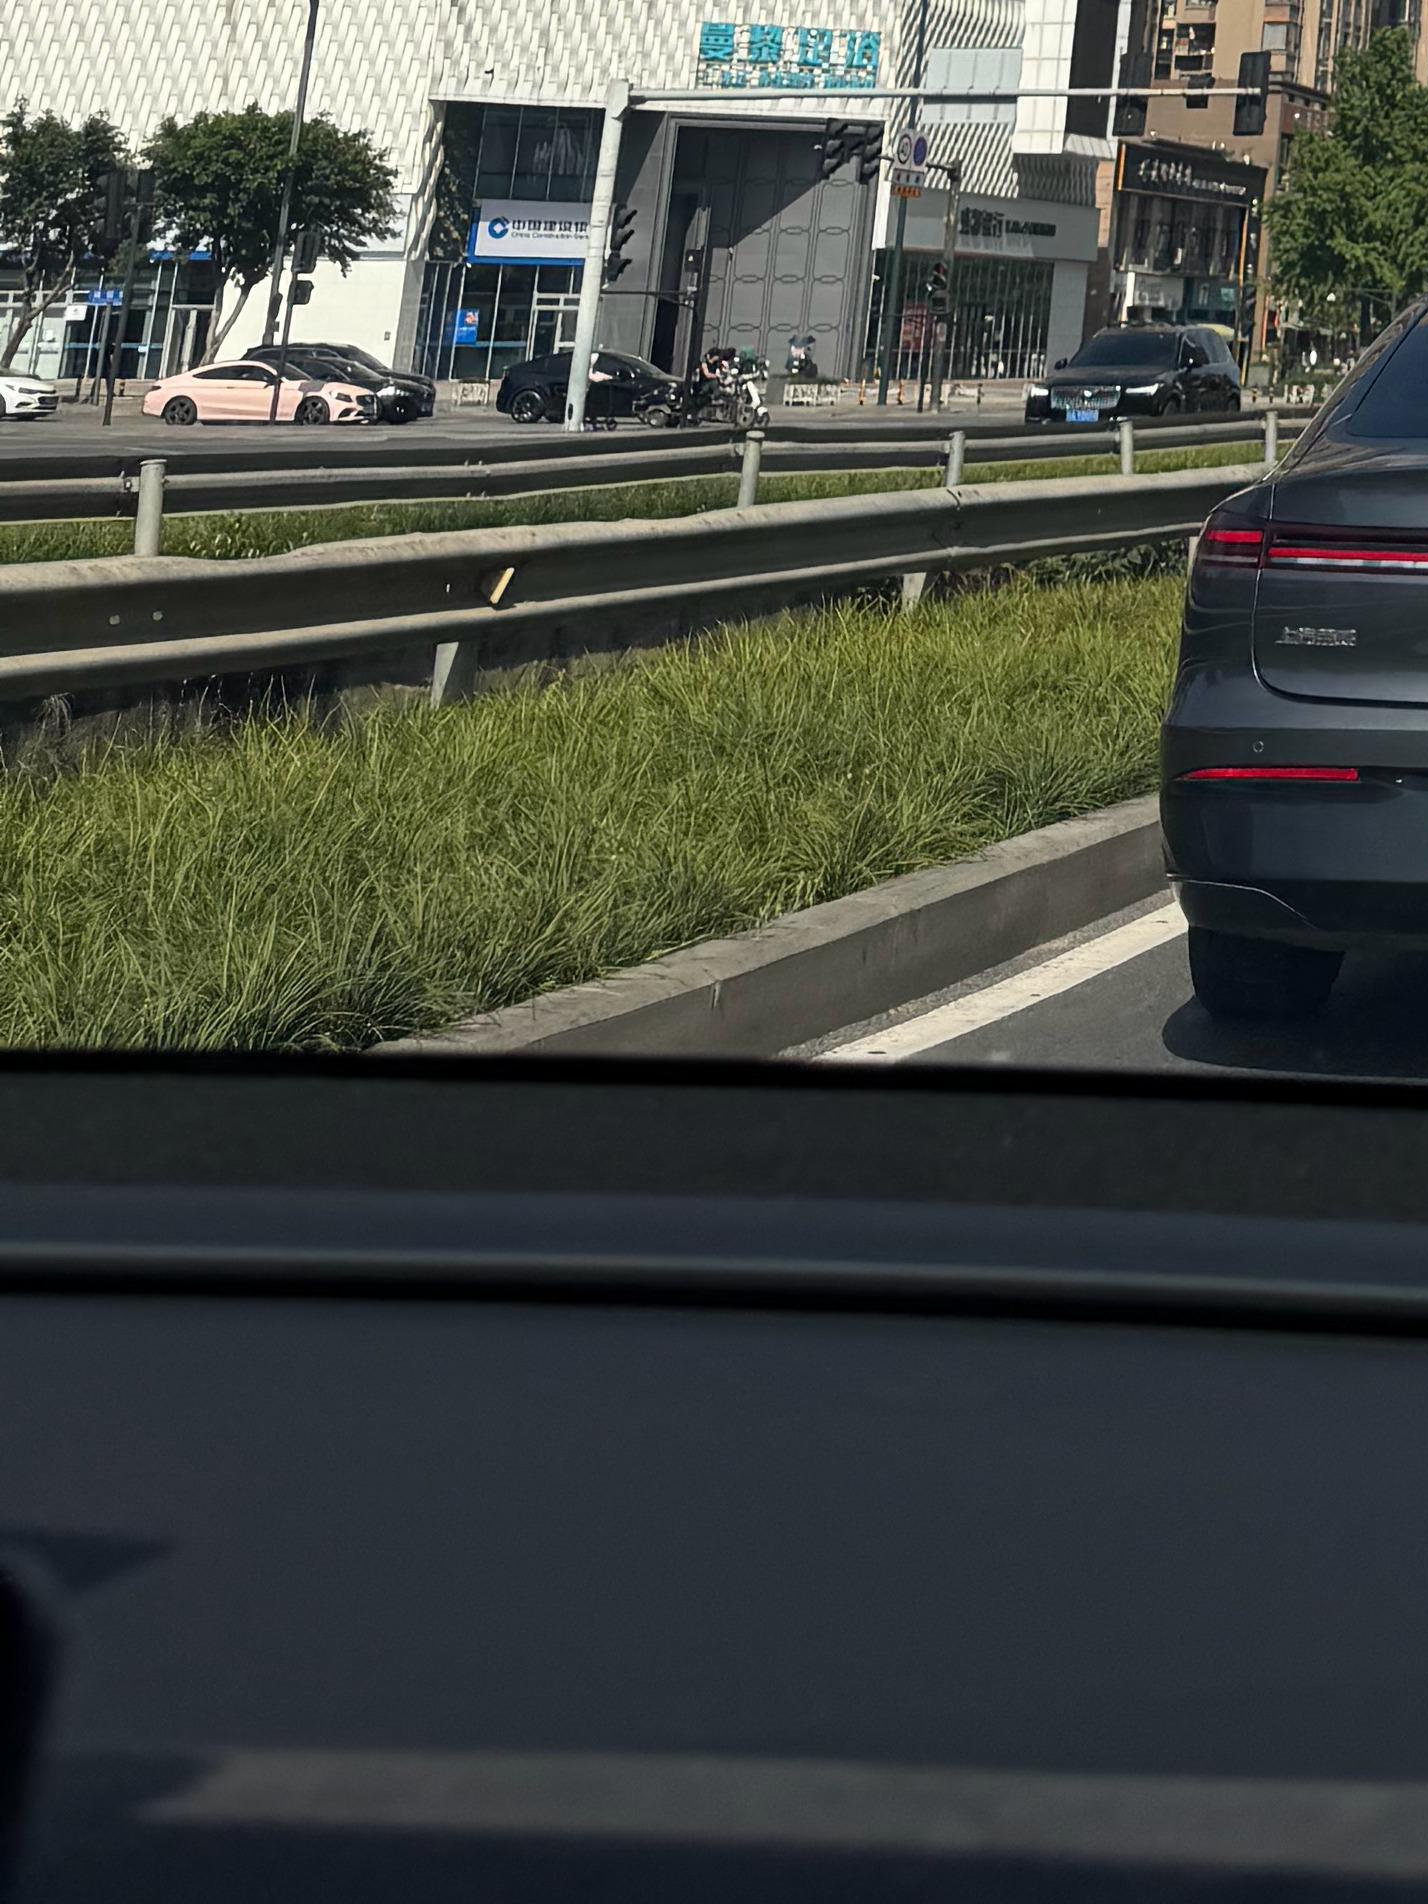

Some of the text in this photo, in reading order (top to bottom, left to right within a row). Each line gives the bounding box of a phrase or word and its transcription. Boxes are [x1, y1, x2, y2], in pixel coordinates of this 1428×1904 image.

[512, 219, 589, 233] 中国建设银
